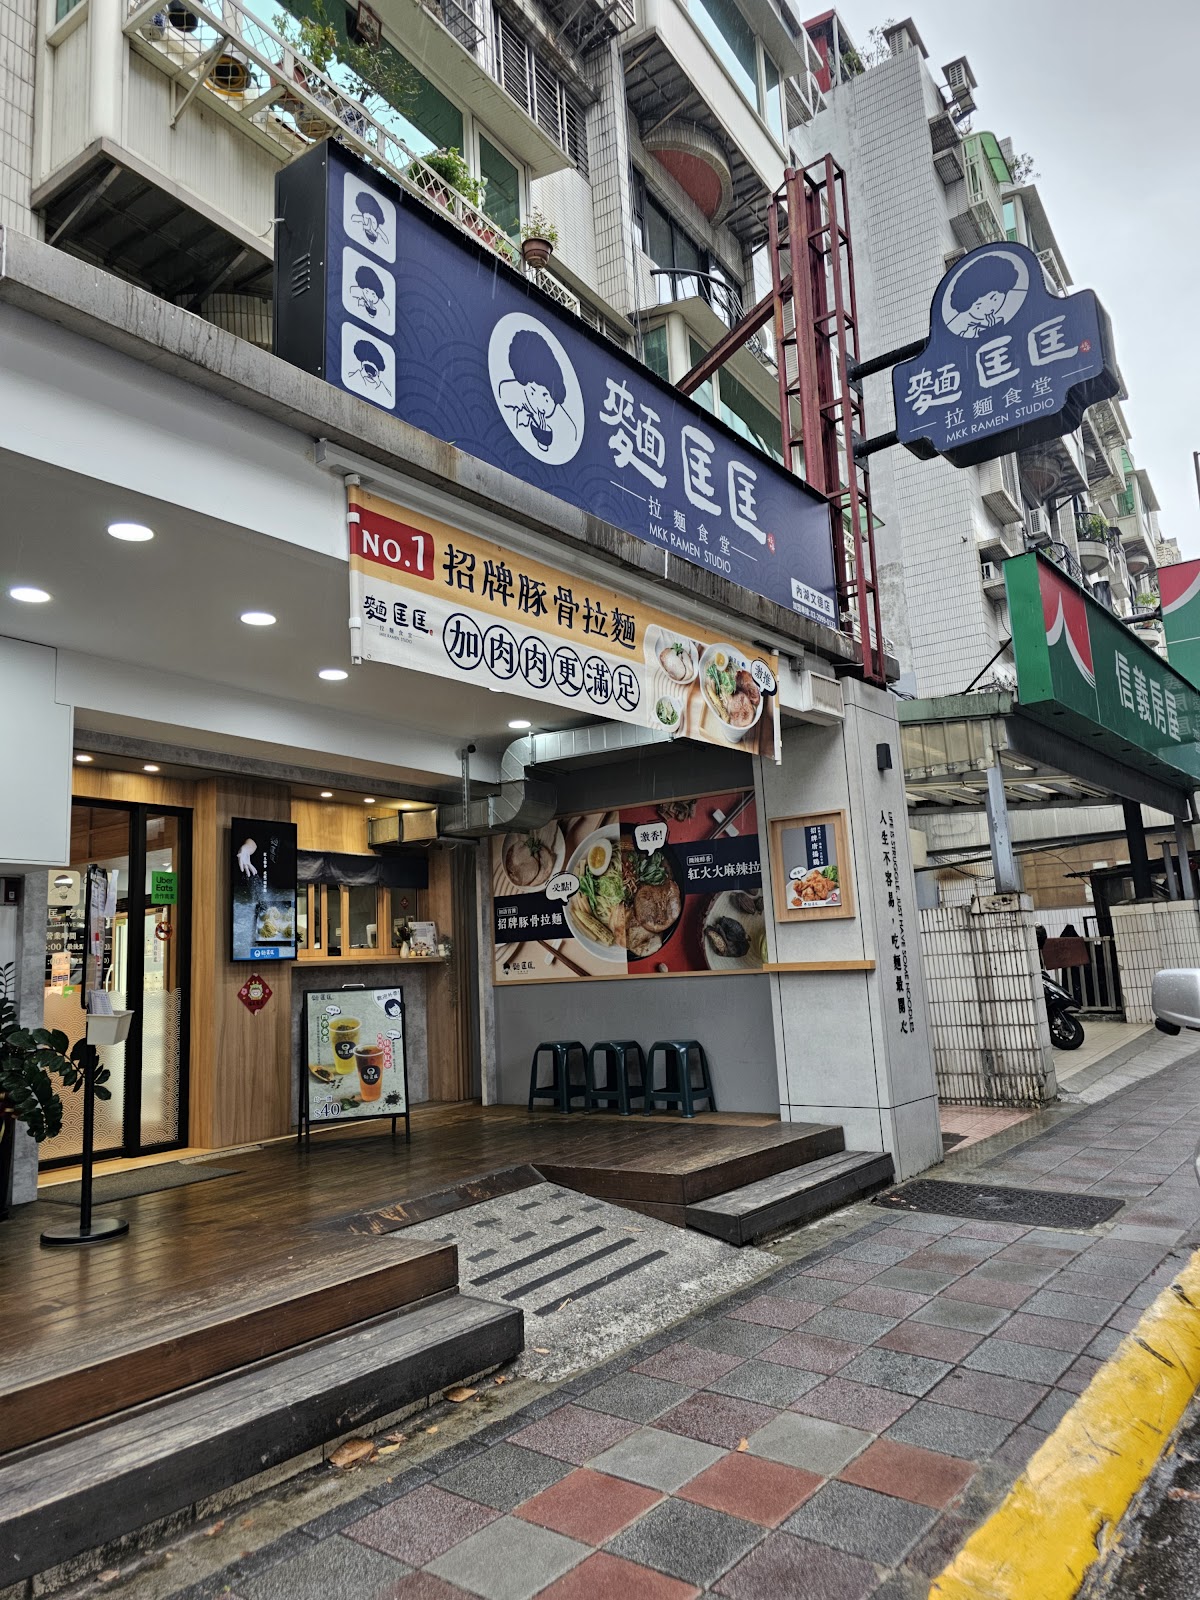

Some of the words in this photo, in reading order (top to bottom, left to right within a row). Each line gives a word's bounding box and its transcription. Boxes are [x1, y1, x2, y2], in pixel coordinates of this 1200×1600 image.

[905, 315, 1078, 415] 麵匡匡
[945, 377, 1053, 428] 拉麵食堂
[946, 428, 968, 443] MKK
[971, 415, 1009, 433] RAMEN
[1015, 399, 1055, 419] STUDIO
[600, 377, 767, 545] 麵匡匡
[362, 530, 425, 571] NO.1
[648, 495, 731, 556] 拉麵食堂
[649, 522, 668, 542] MKK
[670, 532, 700, 558] RAMEN
[704, 550, 731, 574] STUDIO
[363, 595, 429, 633] 麵匡匡
[443, 544, 637, 650] 招牌豚骨拉麵
[448, 619, 639, 710] 加肉肉更滿足
[1115, 650, 1181, 742] 信義房屋
[552, 881, 572, 892] 必點!
[498, 913, 562, 930] 招牌豚骨拉麵
[896, 896, 904, 918] JUST
[905, 982, 915, 1033] NOODLES
[314, 1103, 341, 1118] $40
